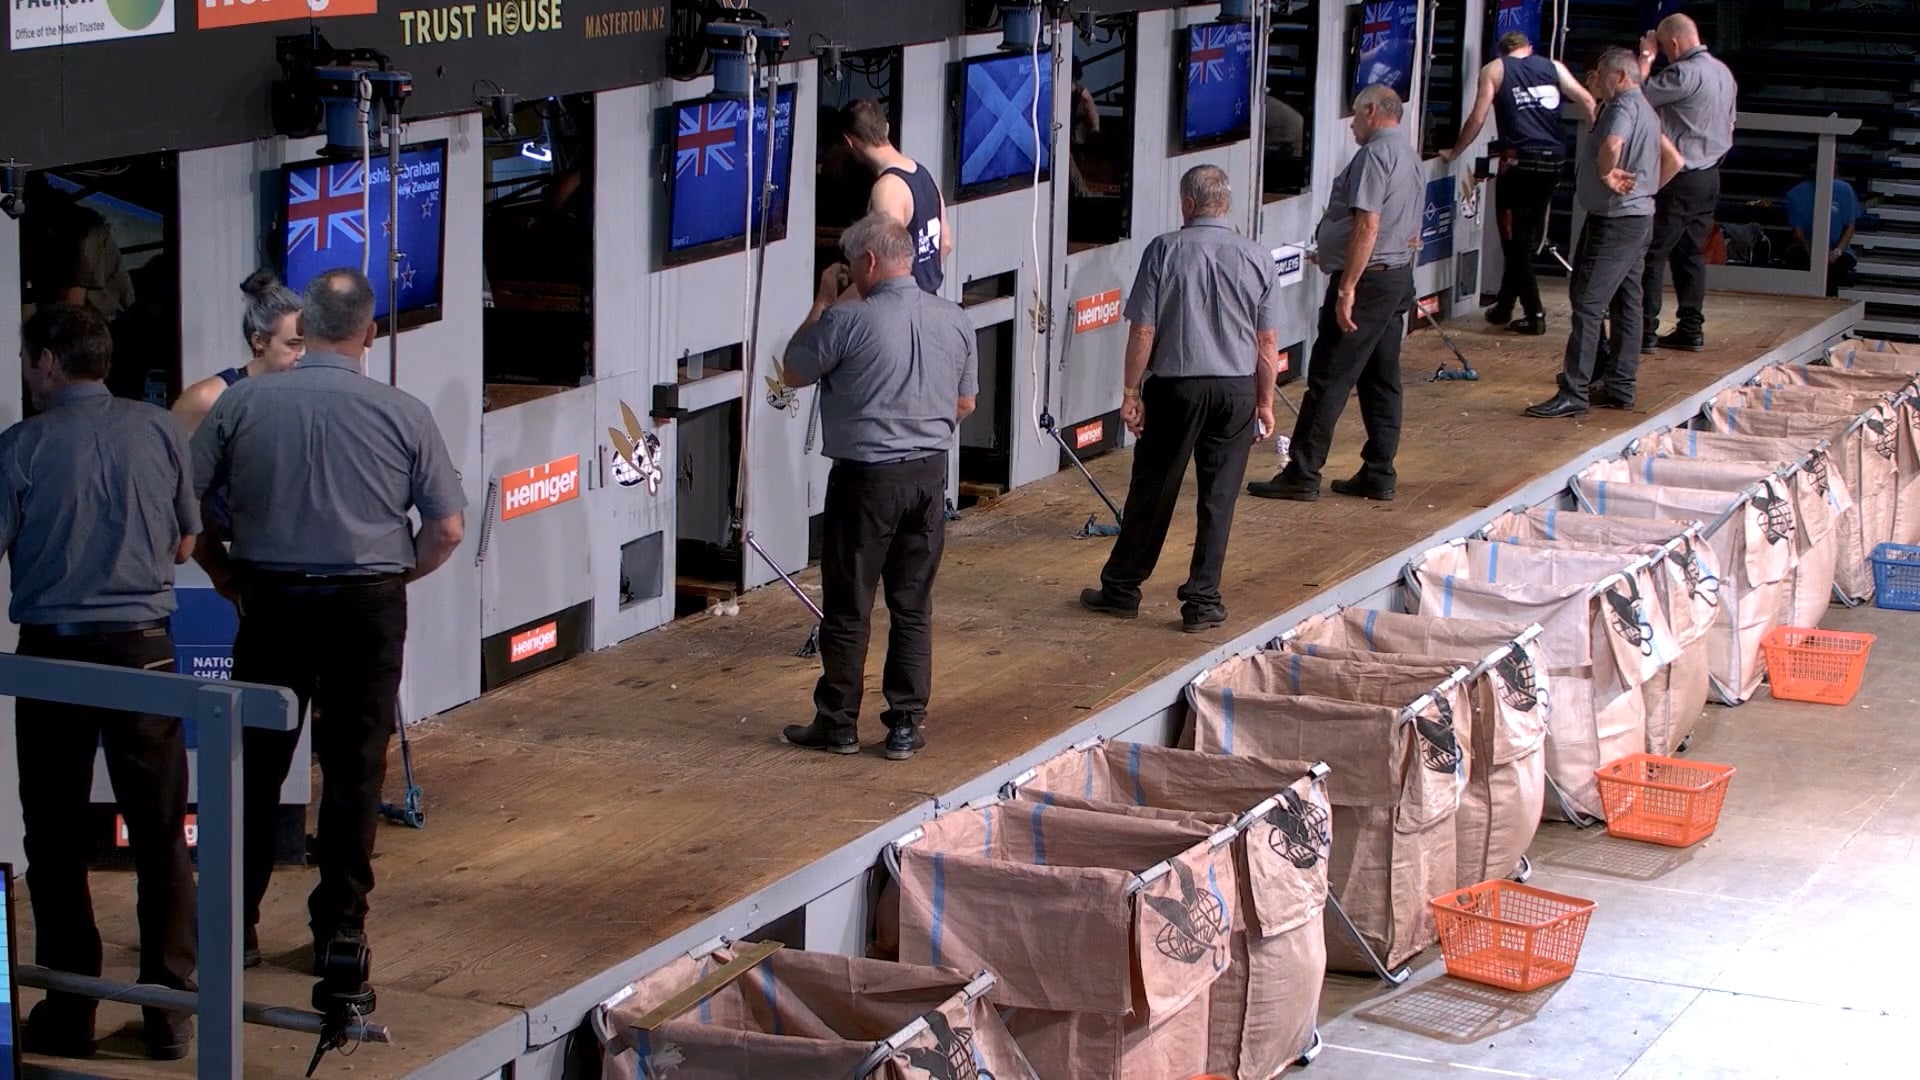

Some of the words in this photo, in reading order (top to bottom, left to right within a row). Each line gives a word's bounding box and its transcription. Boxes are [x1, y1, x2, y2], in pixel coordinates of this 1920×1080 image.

[15, 27, 36, 40] Office
[36, 26, 45, 37] of
[45, 25, 57, 36] the
[79, 21, 105, 33] Trustee
[399, 5, 476, 46] TRUST
[487, 0, 562, 37] HOUSE
[585, 6, 665, 40] MASTERTON.NZ
[397, 160, 440, 180] braham
[411, 178, 440, 193] Zealand
[1077, 294, 1120, 327] Heiniger
[506, 464, 578, 511] Heiniger
[512, 628, 556, 656] Heiniger
[193, 656, 234, 668] NATIO
[193, 670, 231, 680] SHEA
